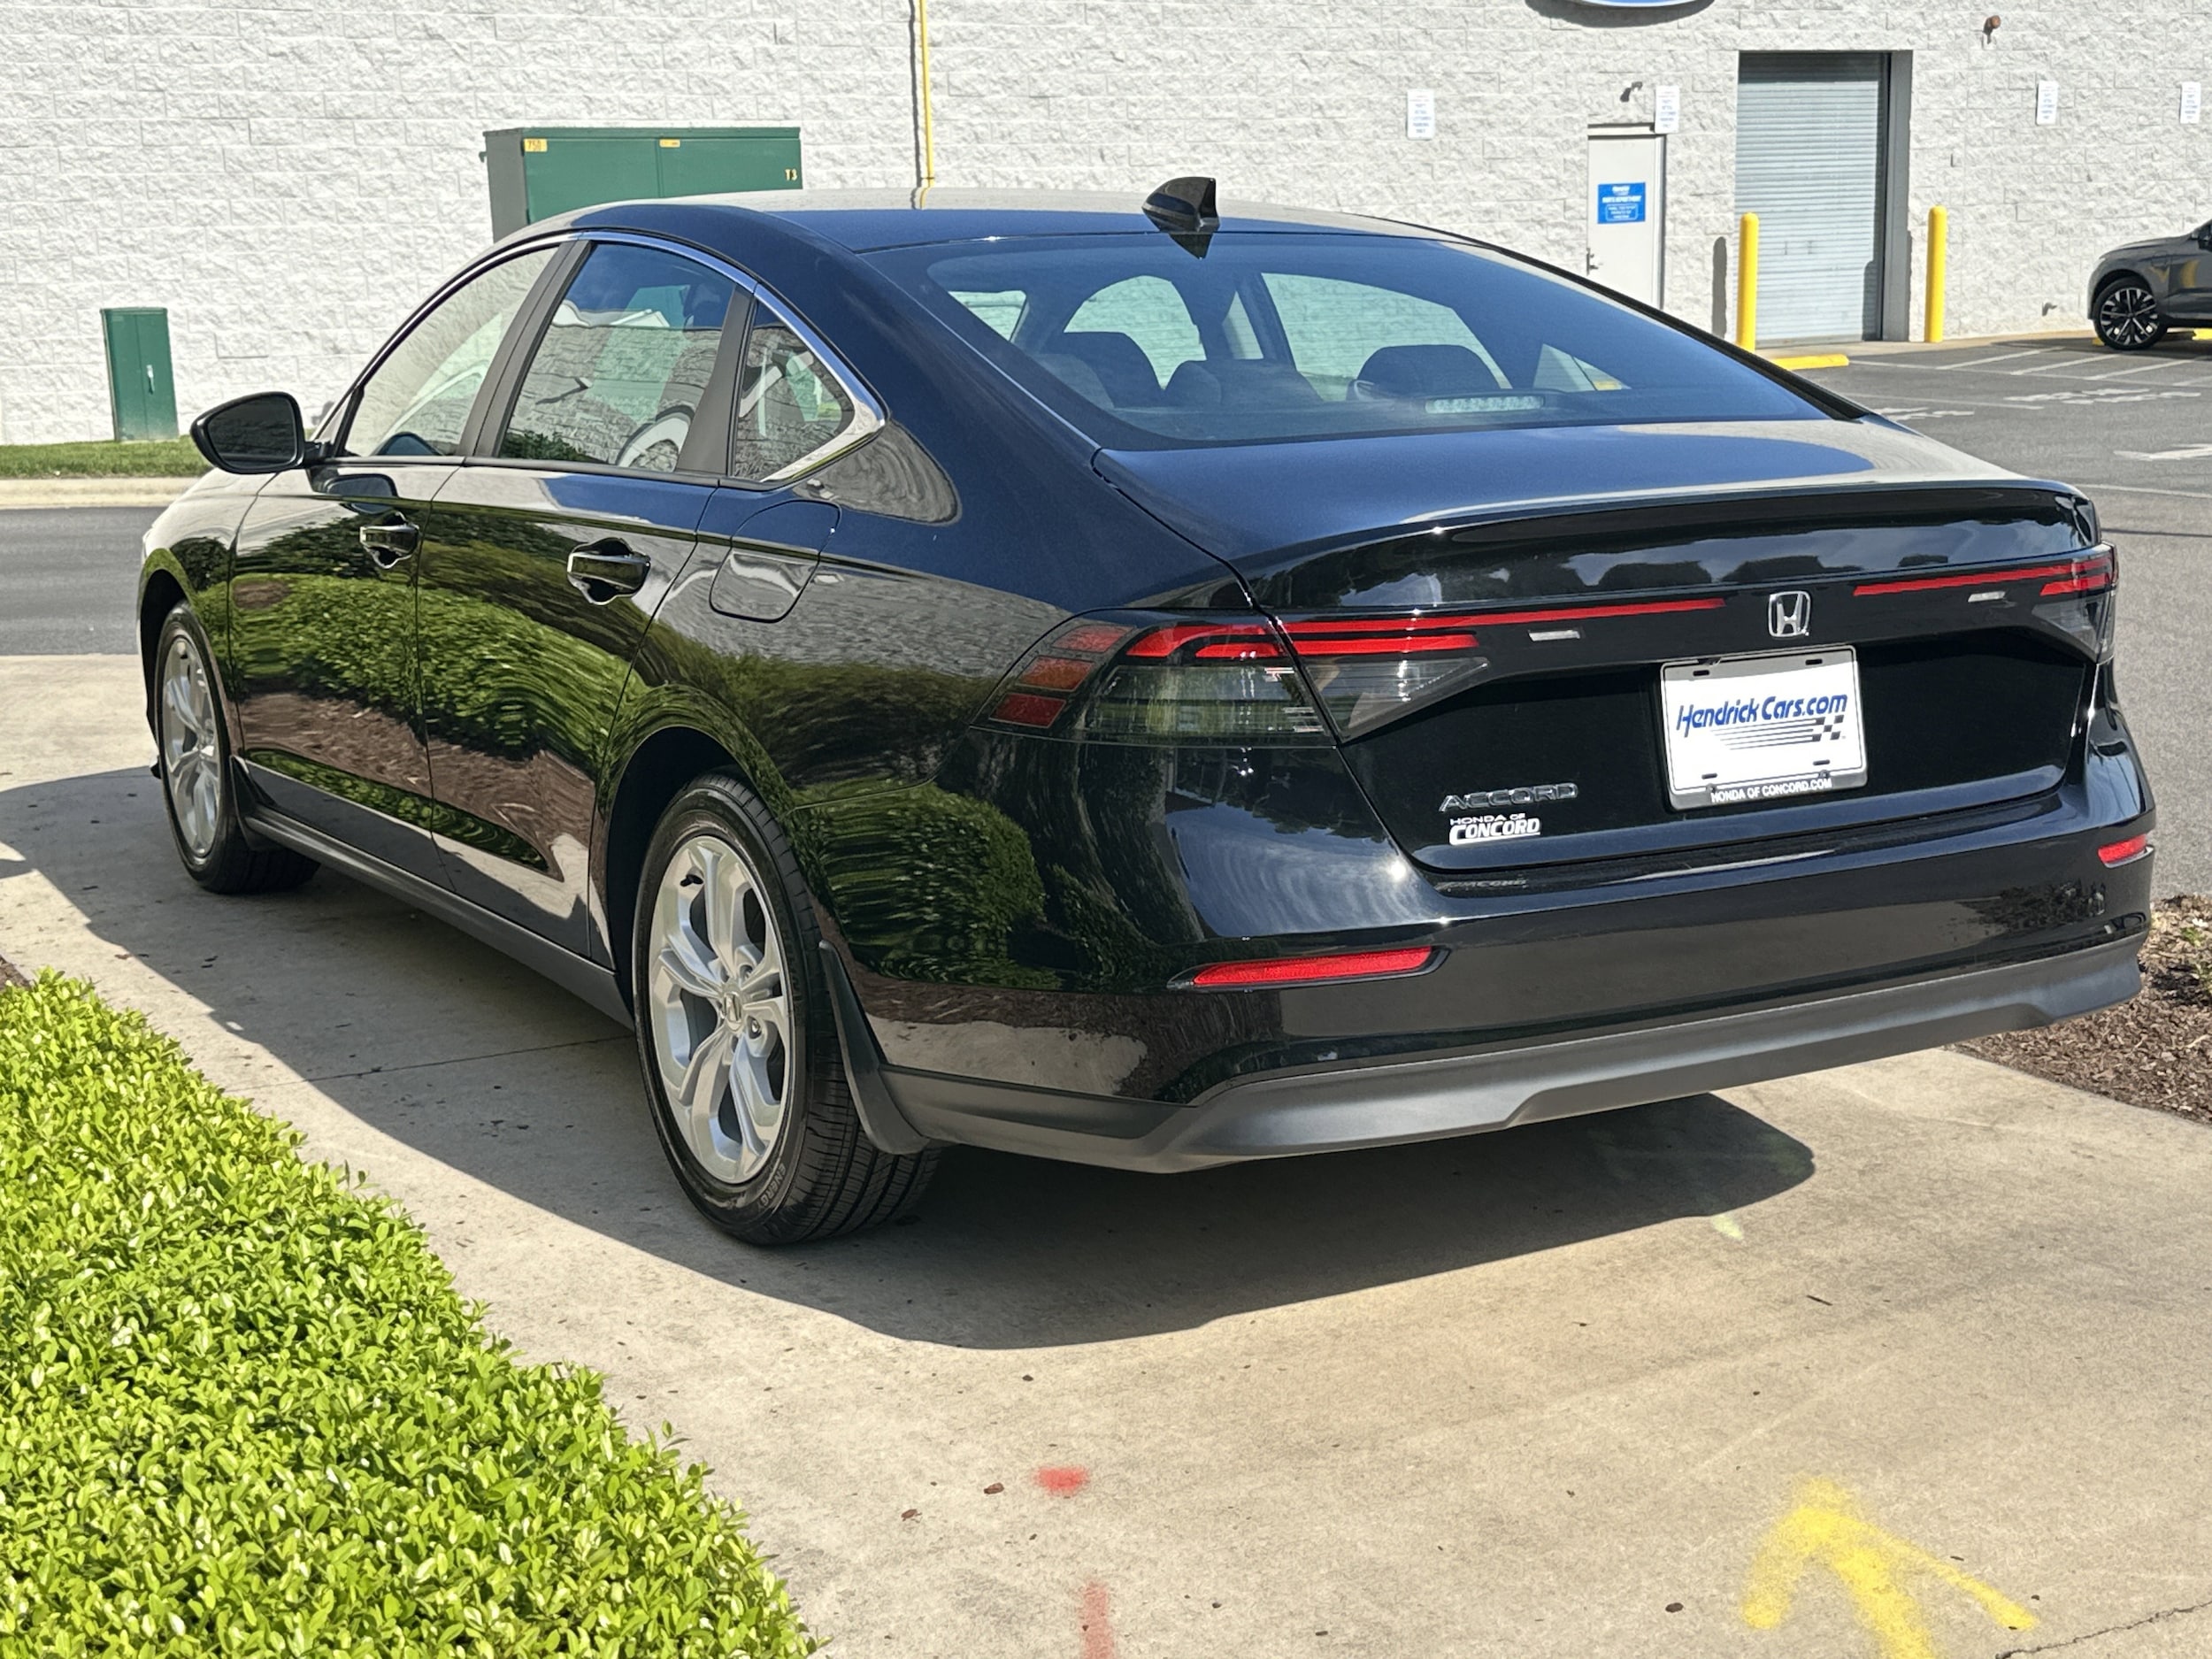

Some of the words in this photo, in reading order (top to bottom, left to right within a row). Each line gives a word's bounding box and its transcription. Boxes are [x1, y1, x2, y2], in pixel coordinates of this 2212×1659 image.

[1677, 697, 1759, 737] Hendrick
[1760, 695, 1847, 720] Cars.com
[1439, 782, 1578, 812] ACCORD
[1711, 789, 1745, 803] HONDA
[1747, 787, 1761, 798] OF
[1763, 779, 1832, 796] CONCORD.COM
[1449, 818, 1540, 846] CONCORD
[1450, 814, 1506, 826] HONDA
